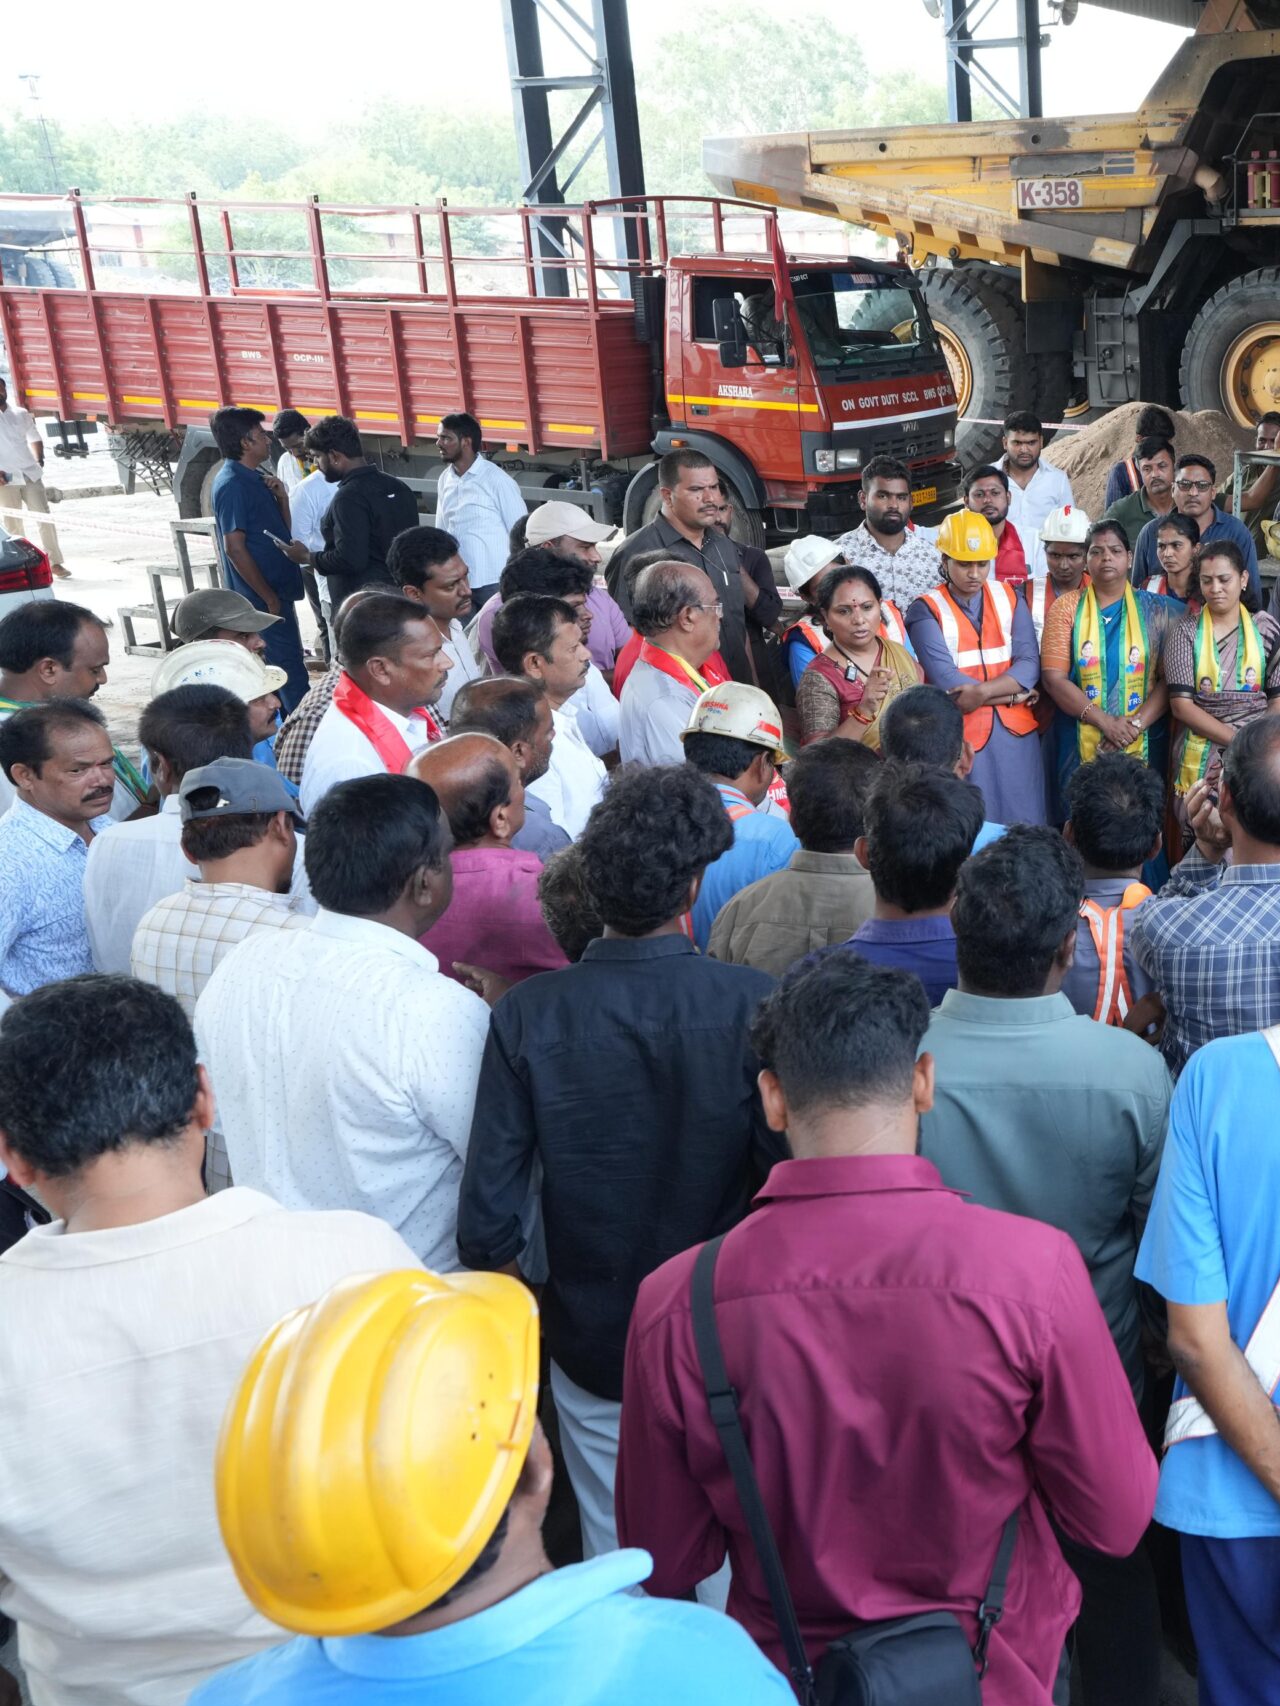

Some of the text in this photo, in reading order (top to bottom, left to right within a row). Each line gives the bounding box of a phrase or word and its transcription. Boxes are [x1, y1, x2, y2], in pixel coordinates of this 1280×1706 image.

[1020, 181, 1080, 206] K-358
[718, 384, 753, 398] AKSHARA
[842, 399, 855, 411] ON
[858, 395, 879, 409] GOVT
[880, 393, 899, 406] DUTY
[902, 391, 919, 402] SCCL
